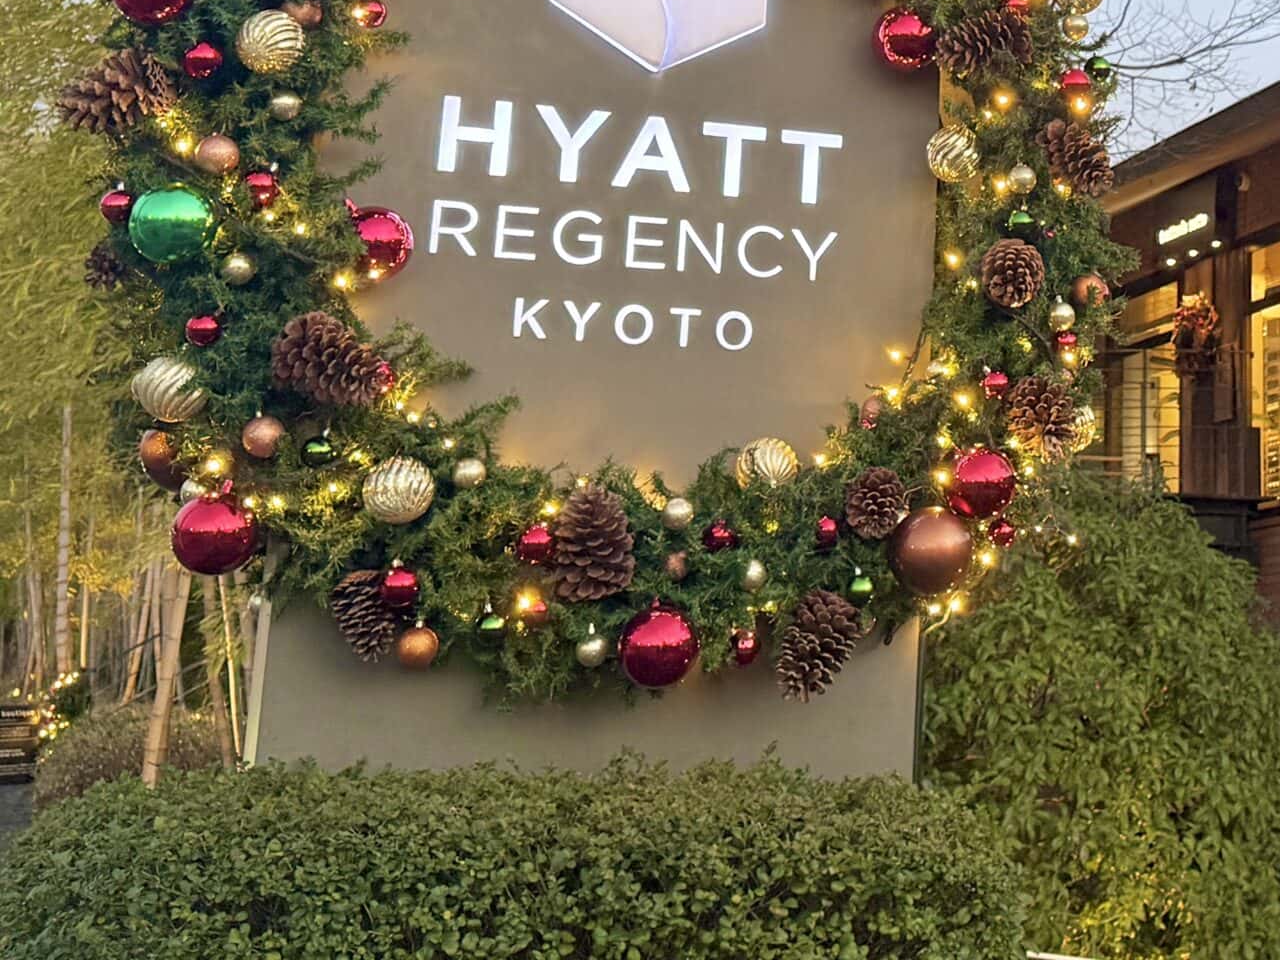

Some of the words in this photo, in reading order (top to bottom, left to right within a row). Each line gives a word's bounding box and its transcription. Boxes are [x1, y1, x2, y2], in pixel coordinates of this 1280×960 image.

[435, 94, 844, 206] HYATT
[428, 198, 839, 282] REGENCY
[512, 296, 754, 351] KYOTO
